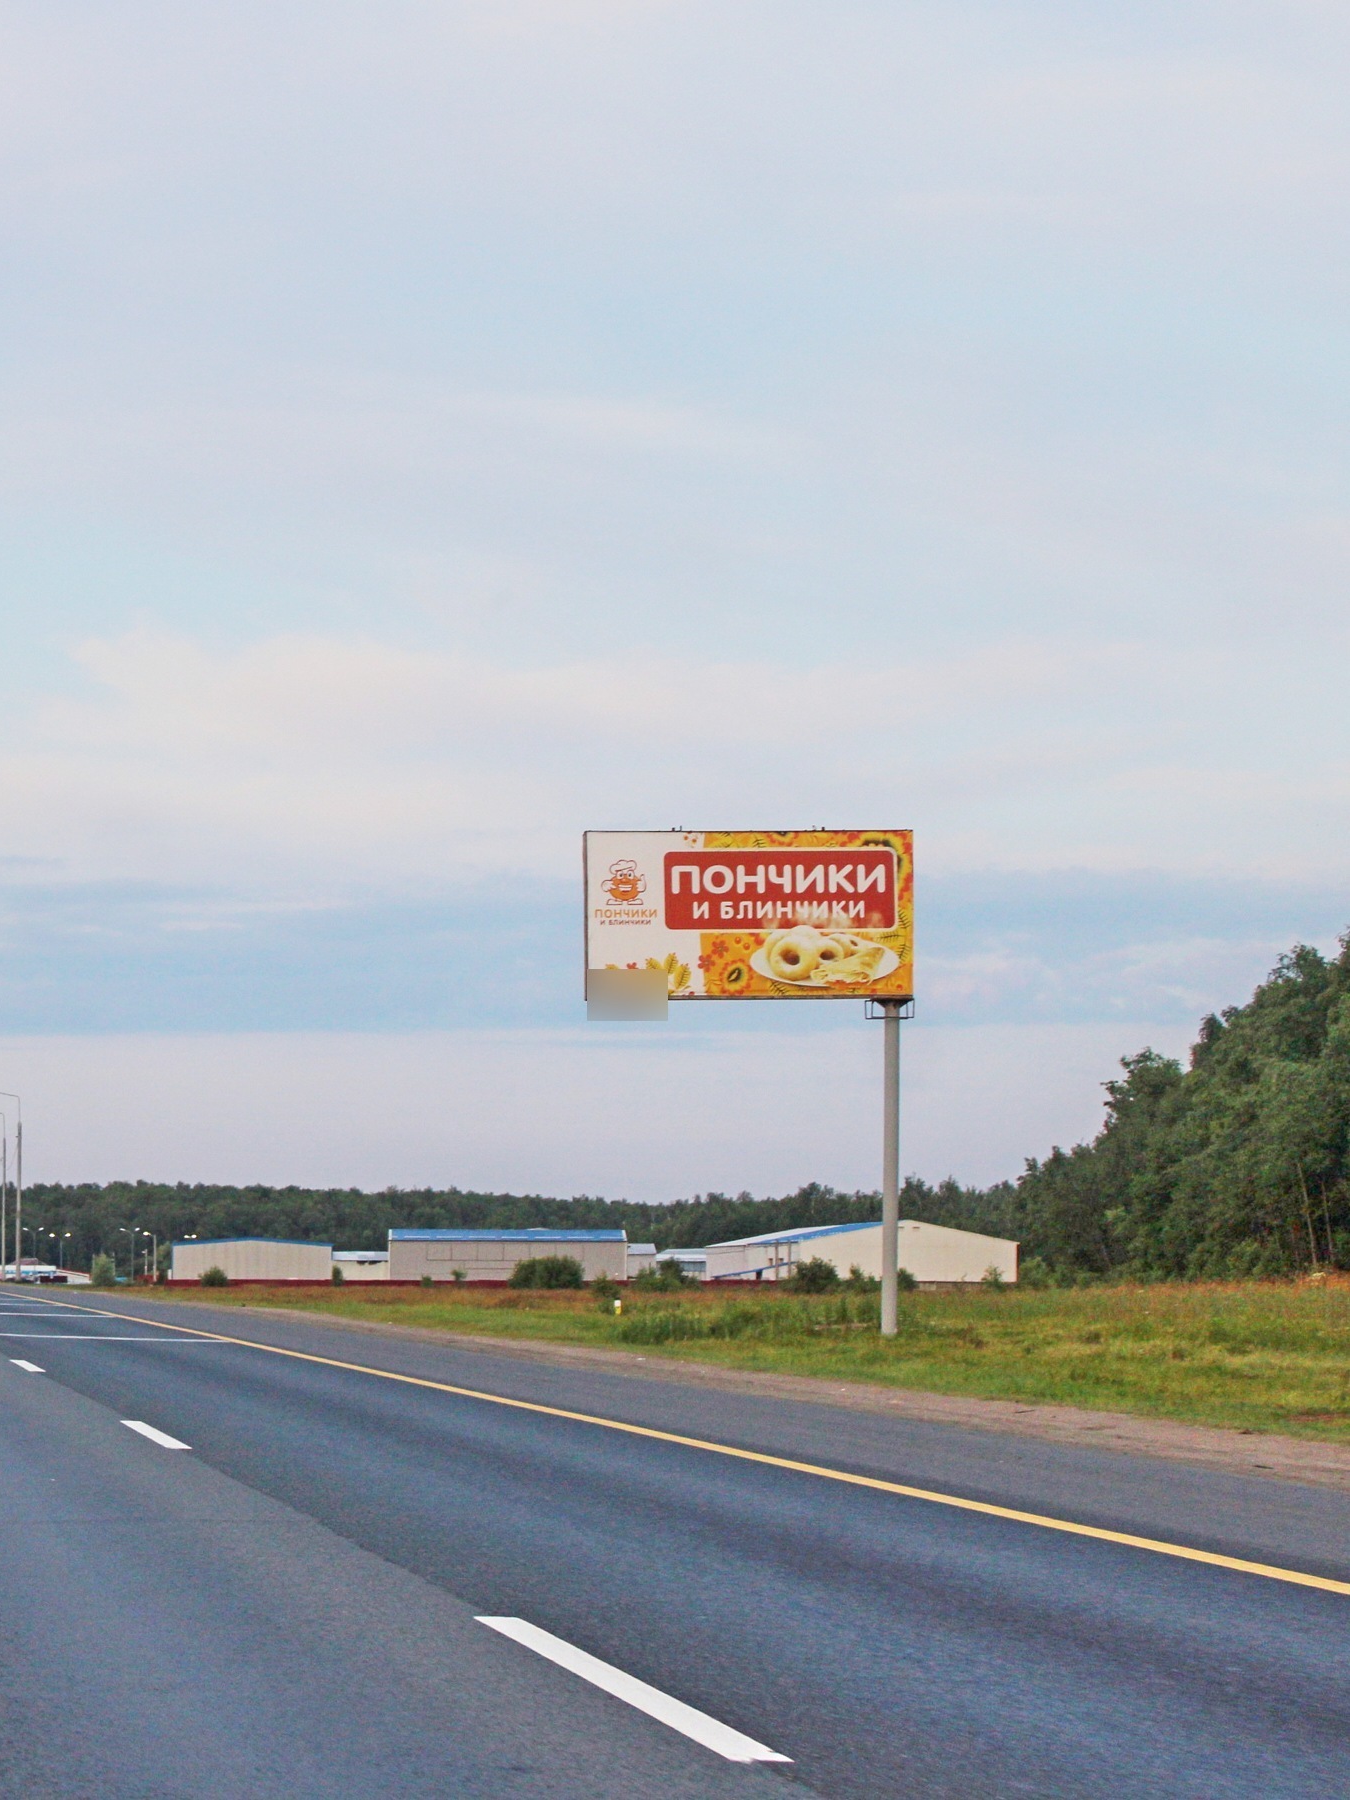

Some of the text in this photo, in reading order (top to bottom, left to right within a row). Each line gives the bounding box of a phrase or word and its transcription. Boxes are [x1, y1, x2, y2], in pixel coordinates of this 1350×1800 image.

[671, 864, 886, 894] ПОНЧИКИ
[594, 908, 658, 918] ПОНЧИКИ
[692, 900, 865, 919] И БЛИНЧИКИ
